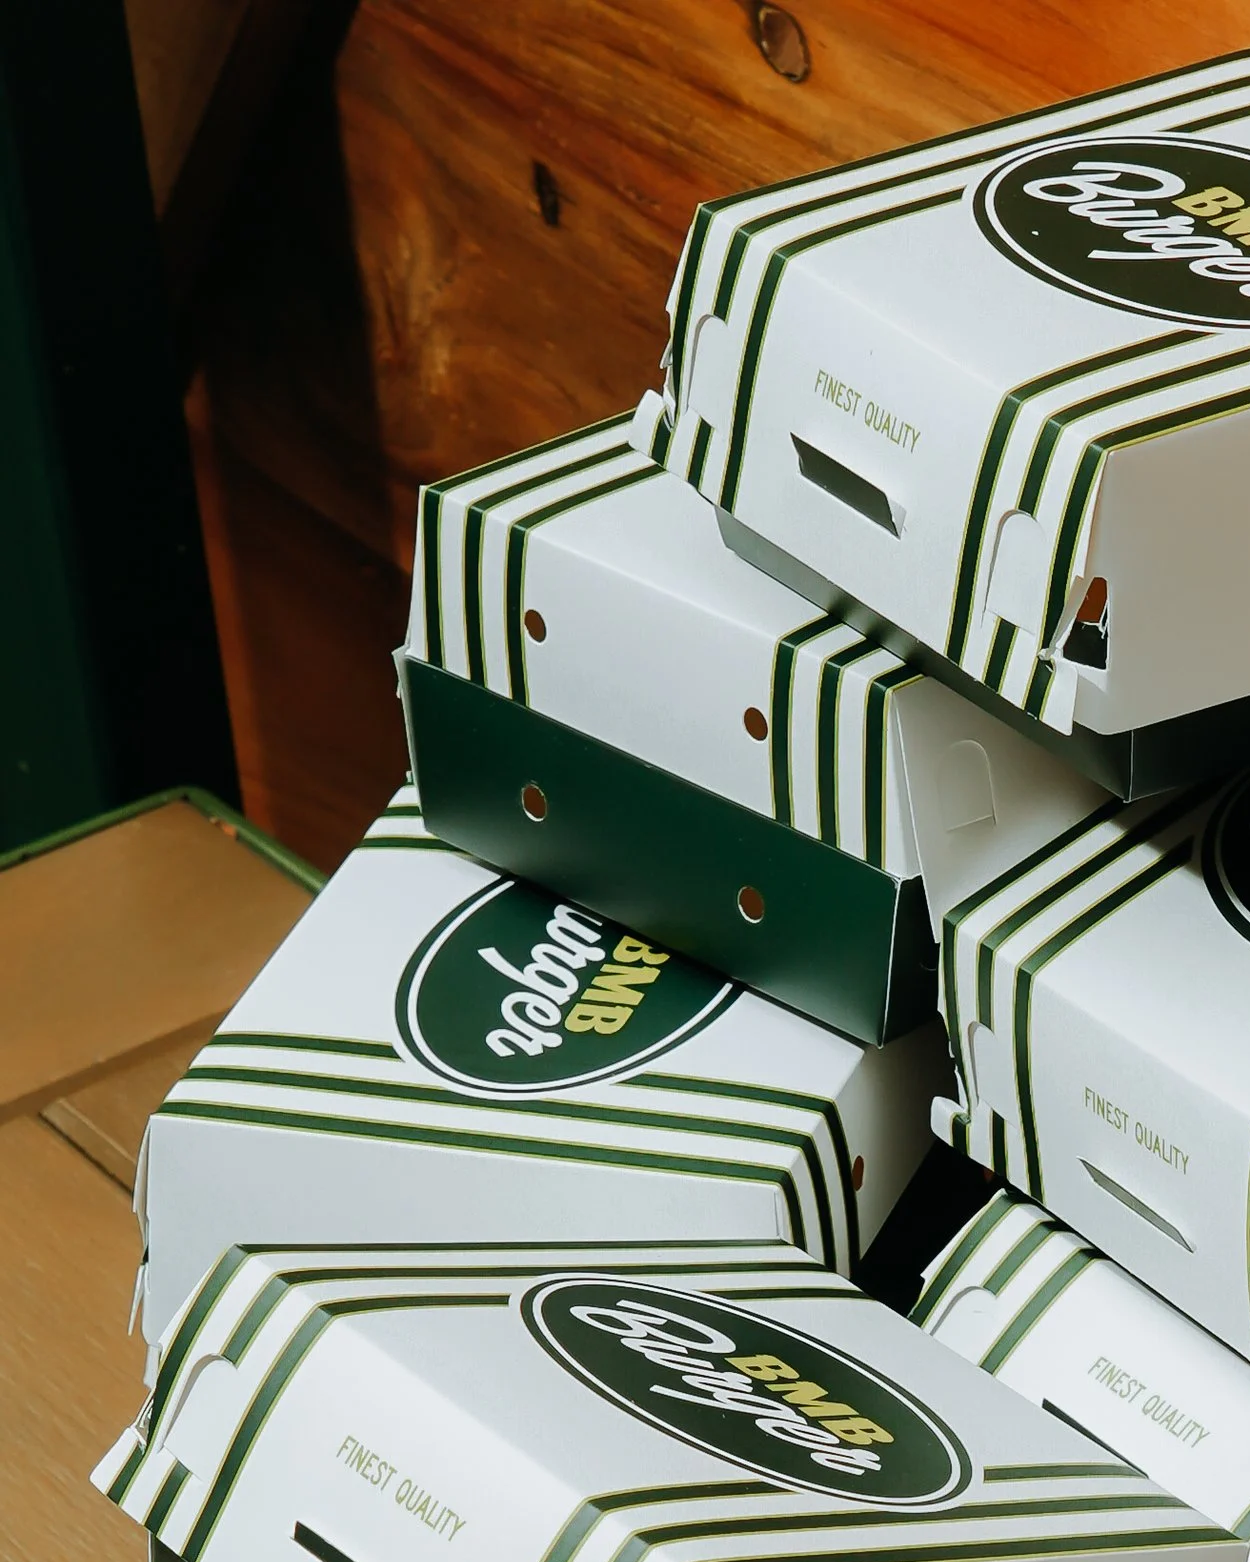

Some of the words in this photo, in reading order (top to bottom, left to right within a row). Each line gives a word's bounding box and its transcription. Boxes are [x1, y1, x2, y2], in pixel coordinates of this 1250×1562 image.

[813, 367, 862, 417] FINEST
[863, 402, 920, 453] QUALITY
[477, 904, 606, 1058] urger
[564, 935, 670, 1035] BMB
[1083, 1086, 1130, 1135] FINEST
[1134, 1121, 1189, 1175] QUALITY
[569, 1300, 882, 1476] Burger
[732, 1355, 895, 1446] BMB
[1087, 1355, 1142, 1406] FINEST
[1144, 1395, 1211, 1450] QUALITY
[336, 1434, 397, 1490] FINEST
[394, 1478, 467, 1542] QUALITY
